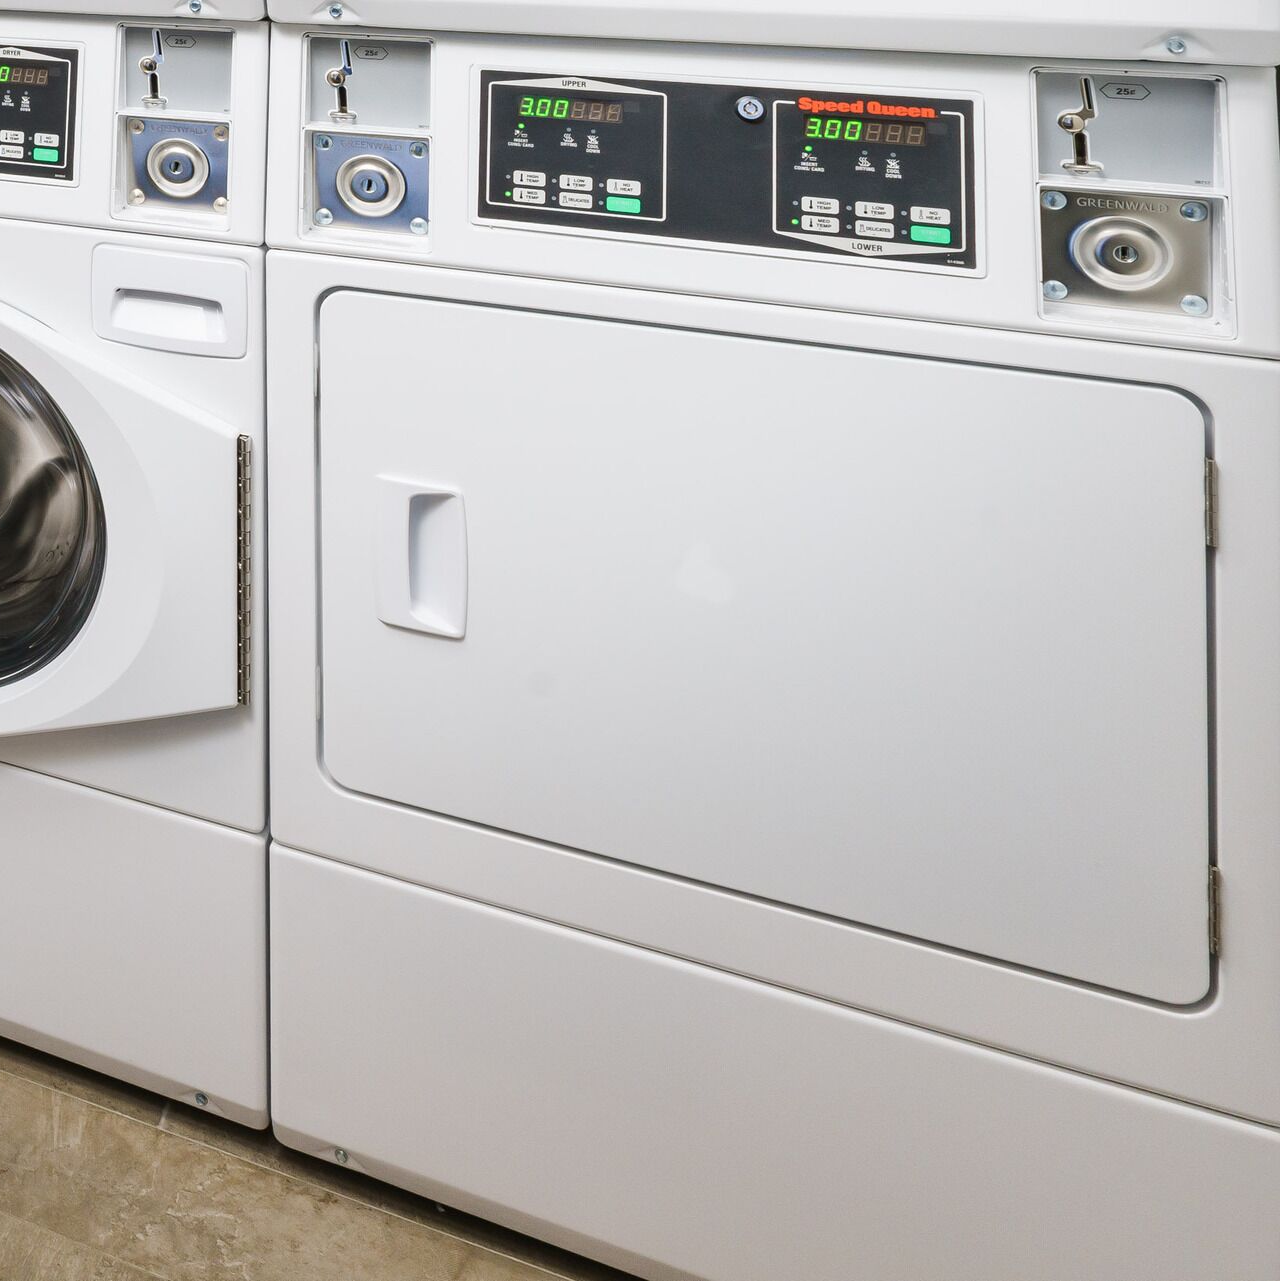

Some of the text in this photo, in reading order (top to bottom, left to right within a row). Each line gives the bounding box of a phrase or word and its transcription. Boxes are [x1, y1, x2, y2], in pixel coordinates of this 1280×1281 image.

[561, 79, 587, 88] UPPER
[1116, 87, 1136, 95] 25¢
[519, 97, 569, 118] 3.00
[798, 96, 936, 118] Speed Queen
[806, 117, 862, 140] 3.00
[341, 140, 402, 152] GREENWALD
[1076, 196, 1169, 213] GREENWALD
[851, 242, 883, 252] LOWER
